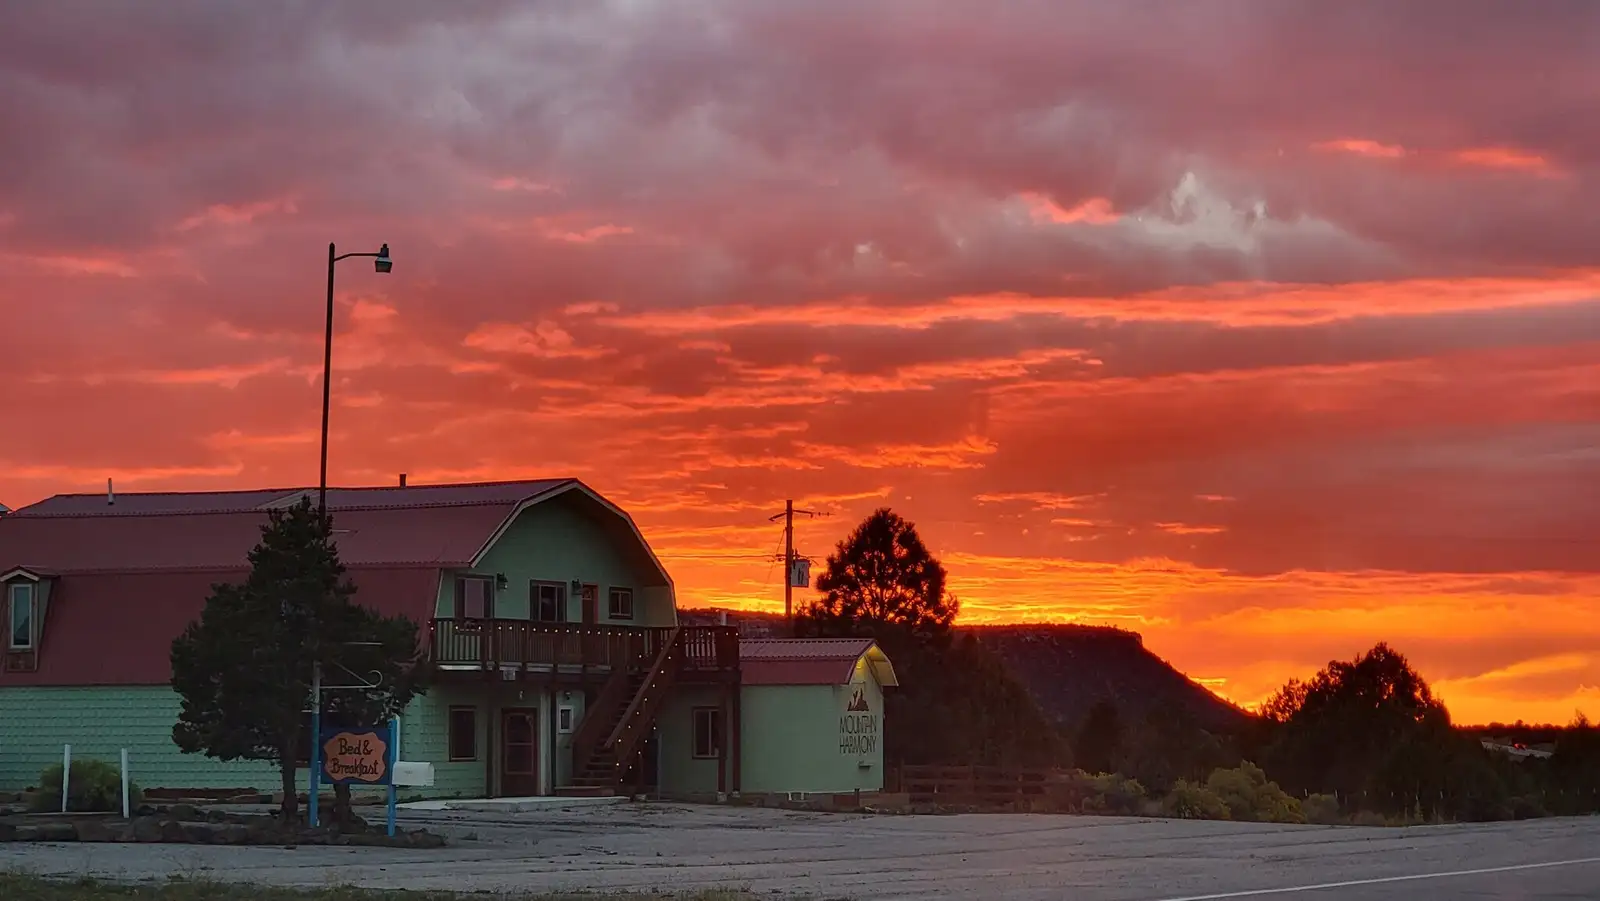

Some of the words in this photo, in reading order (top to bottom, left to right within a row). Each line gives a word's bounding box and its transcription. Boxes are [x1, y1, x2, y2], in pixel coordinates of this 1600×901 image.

[840, 715, 876, 734] MOUNTAIN
[840, 735, 876, 754] HARMONY
[331, 757, 378, 776] Breakfast
